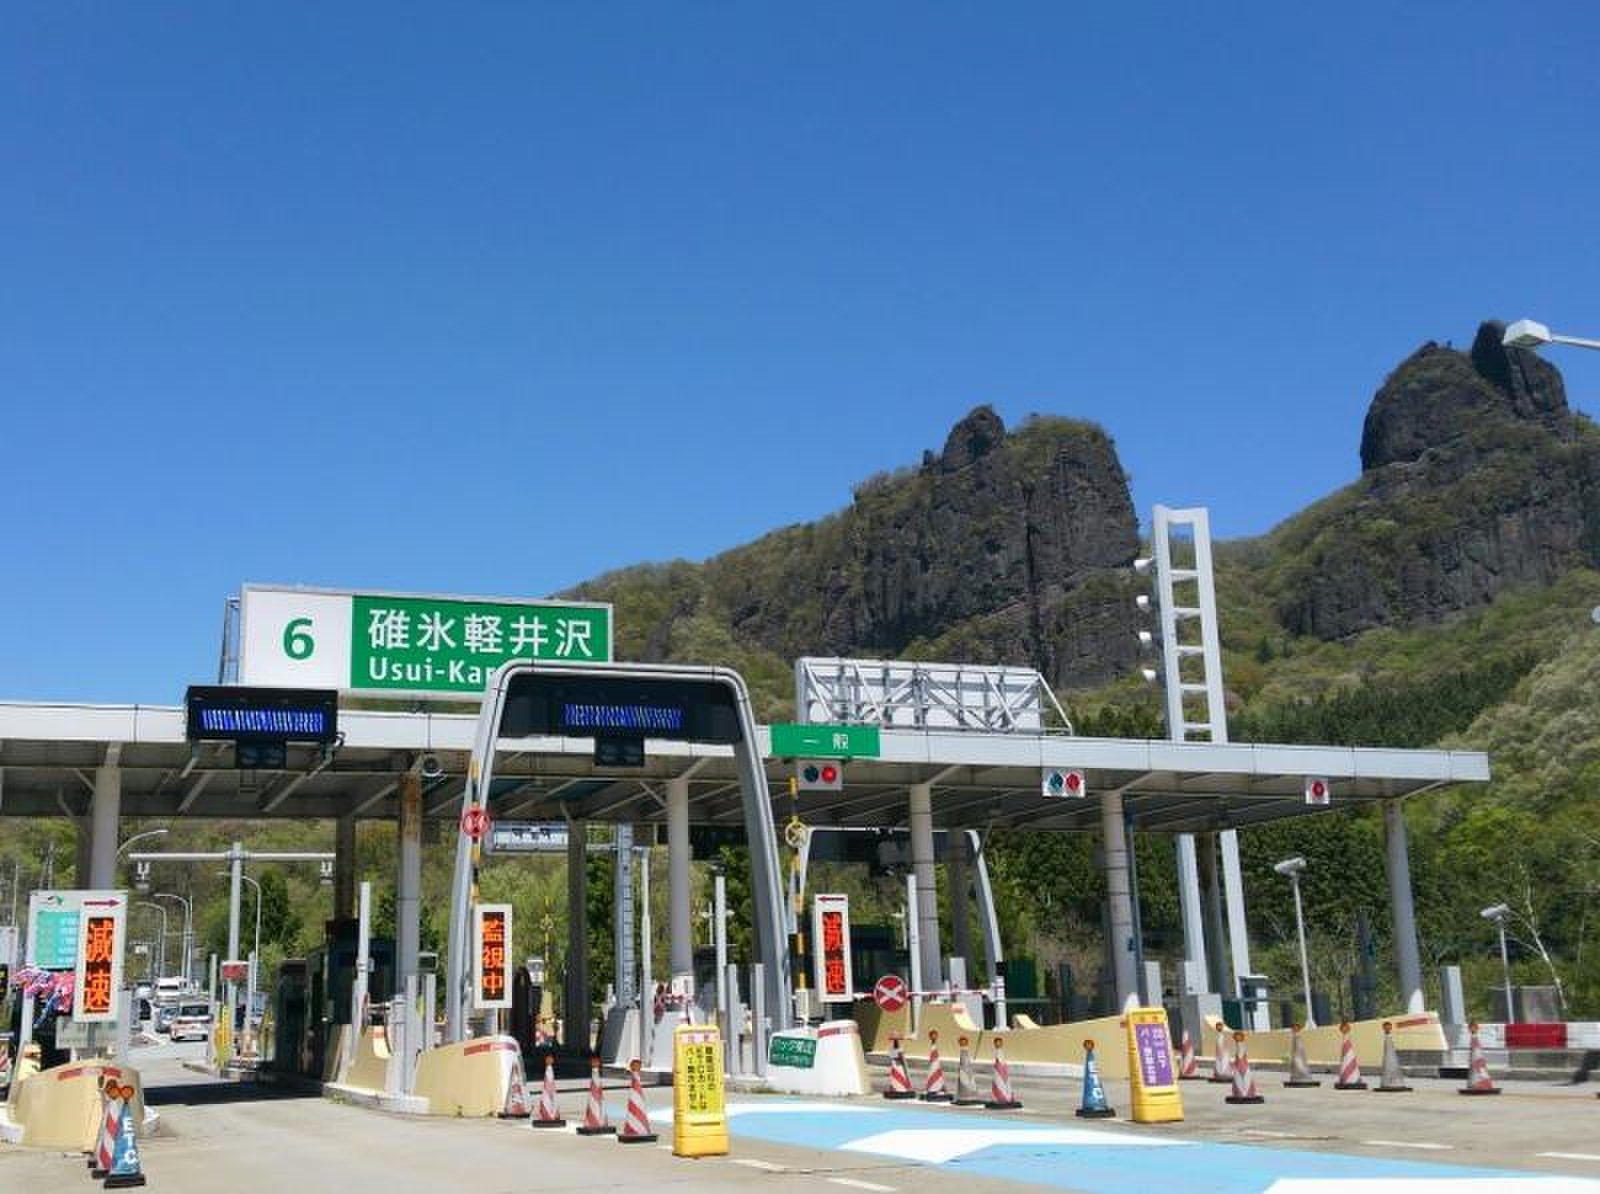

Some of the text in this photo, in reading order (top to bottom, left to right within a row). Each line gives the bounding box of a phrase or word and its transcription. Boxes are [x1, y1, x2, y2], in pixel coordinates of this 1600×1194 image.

[282, 617, 315, 660] 6
[368, 607, 593, 657] 碓氷軽井沢
[802, 732, 849, 751] 一般
[85, 919, 113, 1010] 減速
[122, 1118, 137, 1163] ETC
